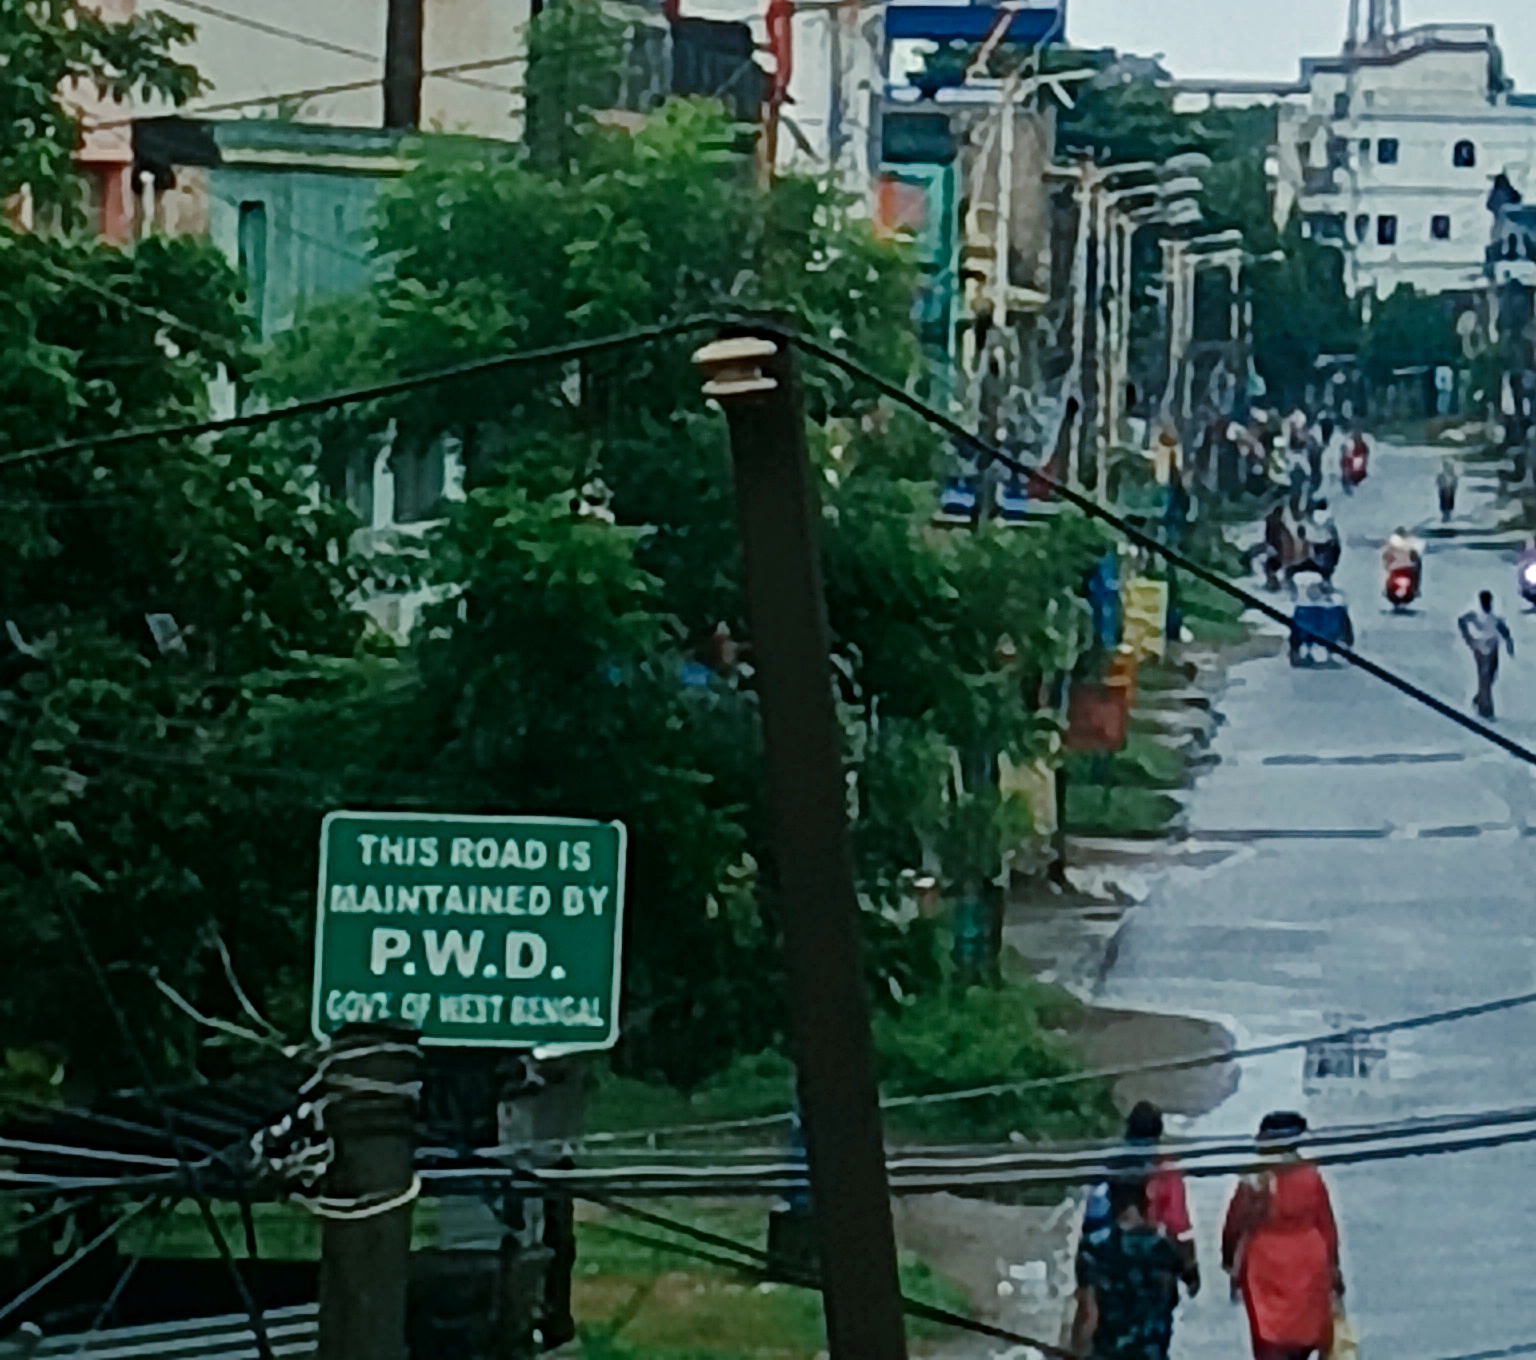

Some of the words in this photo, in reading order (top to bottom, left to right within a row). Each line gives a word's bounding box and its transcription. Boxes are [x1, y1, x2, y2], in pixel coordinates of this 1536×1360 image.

[357, 833, 439, 867] THIS
[451, 836, 548, 870] ROAD
[557, 840, 592, 872] IS
[329, 884, 551, 916] MAINTAINED
[562, 885, 609, 916] BY
[369, 927, 567, 980] P.W.D.
[439, 994, 503, 1023] WEST
